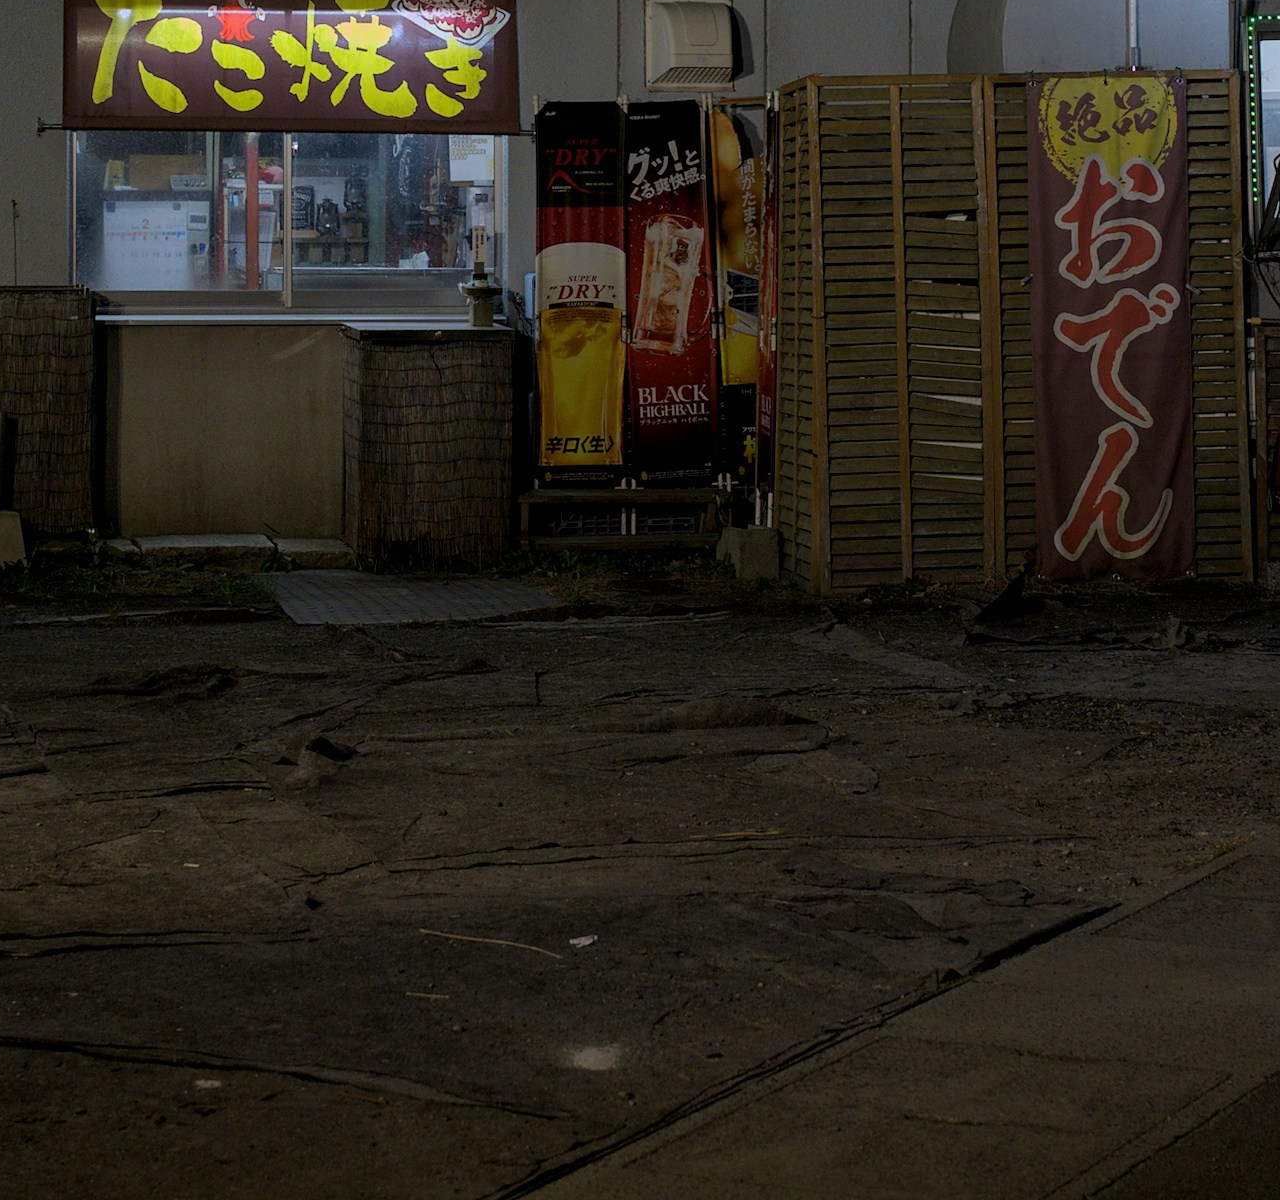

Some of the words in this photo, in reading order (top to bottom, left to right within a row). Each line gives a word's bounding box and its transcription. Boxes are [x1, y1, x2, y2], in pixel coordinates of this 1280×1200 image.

[1055, 84, 1158, 146] 絶品
[1054, 154, 1180, 562] おでん
[637, 384, 710, 405] BLACK
[639, 403, 710, 418] HIGHBALL
